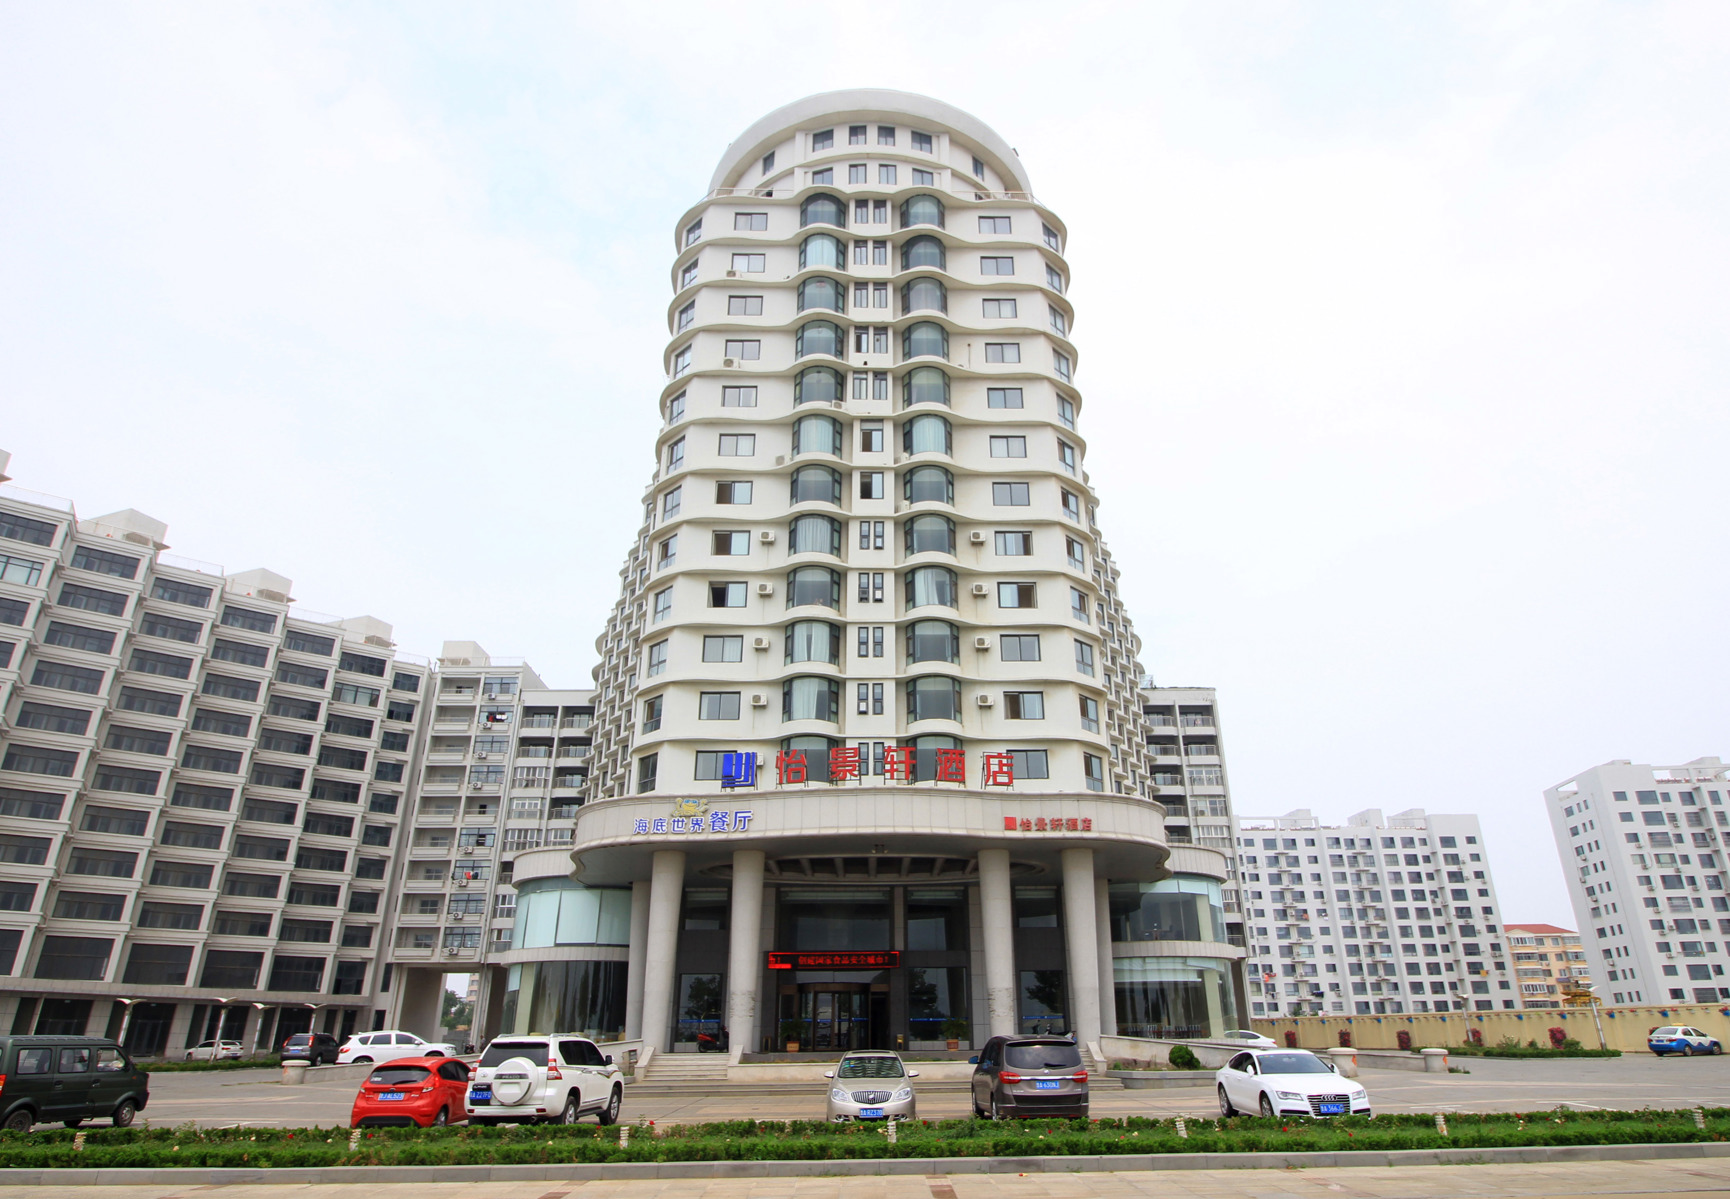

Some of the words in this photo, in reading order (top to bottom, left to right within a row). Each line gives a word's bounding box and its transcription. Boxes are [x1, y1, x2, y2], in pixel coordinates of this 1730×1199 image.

[775, 747, 1013, 786] 怡景轩酒店
[633, 810, 752, 833] 海底世界餐厅
[1020, 817, 1092, 831] 怡景轩酒店
